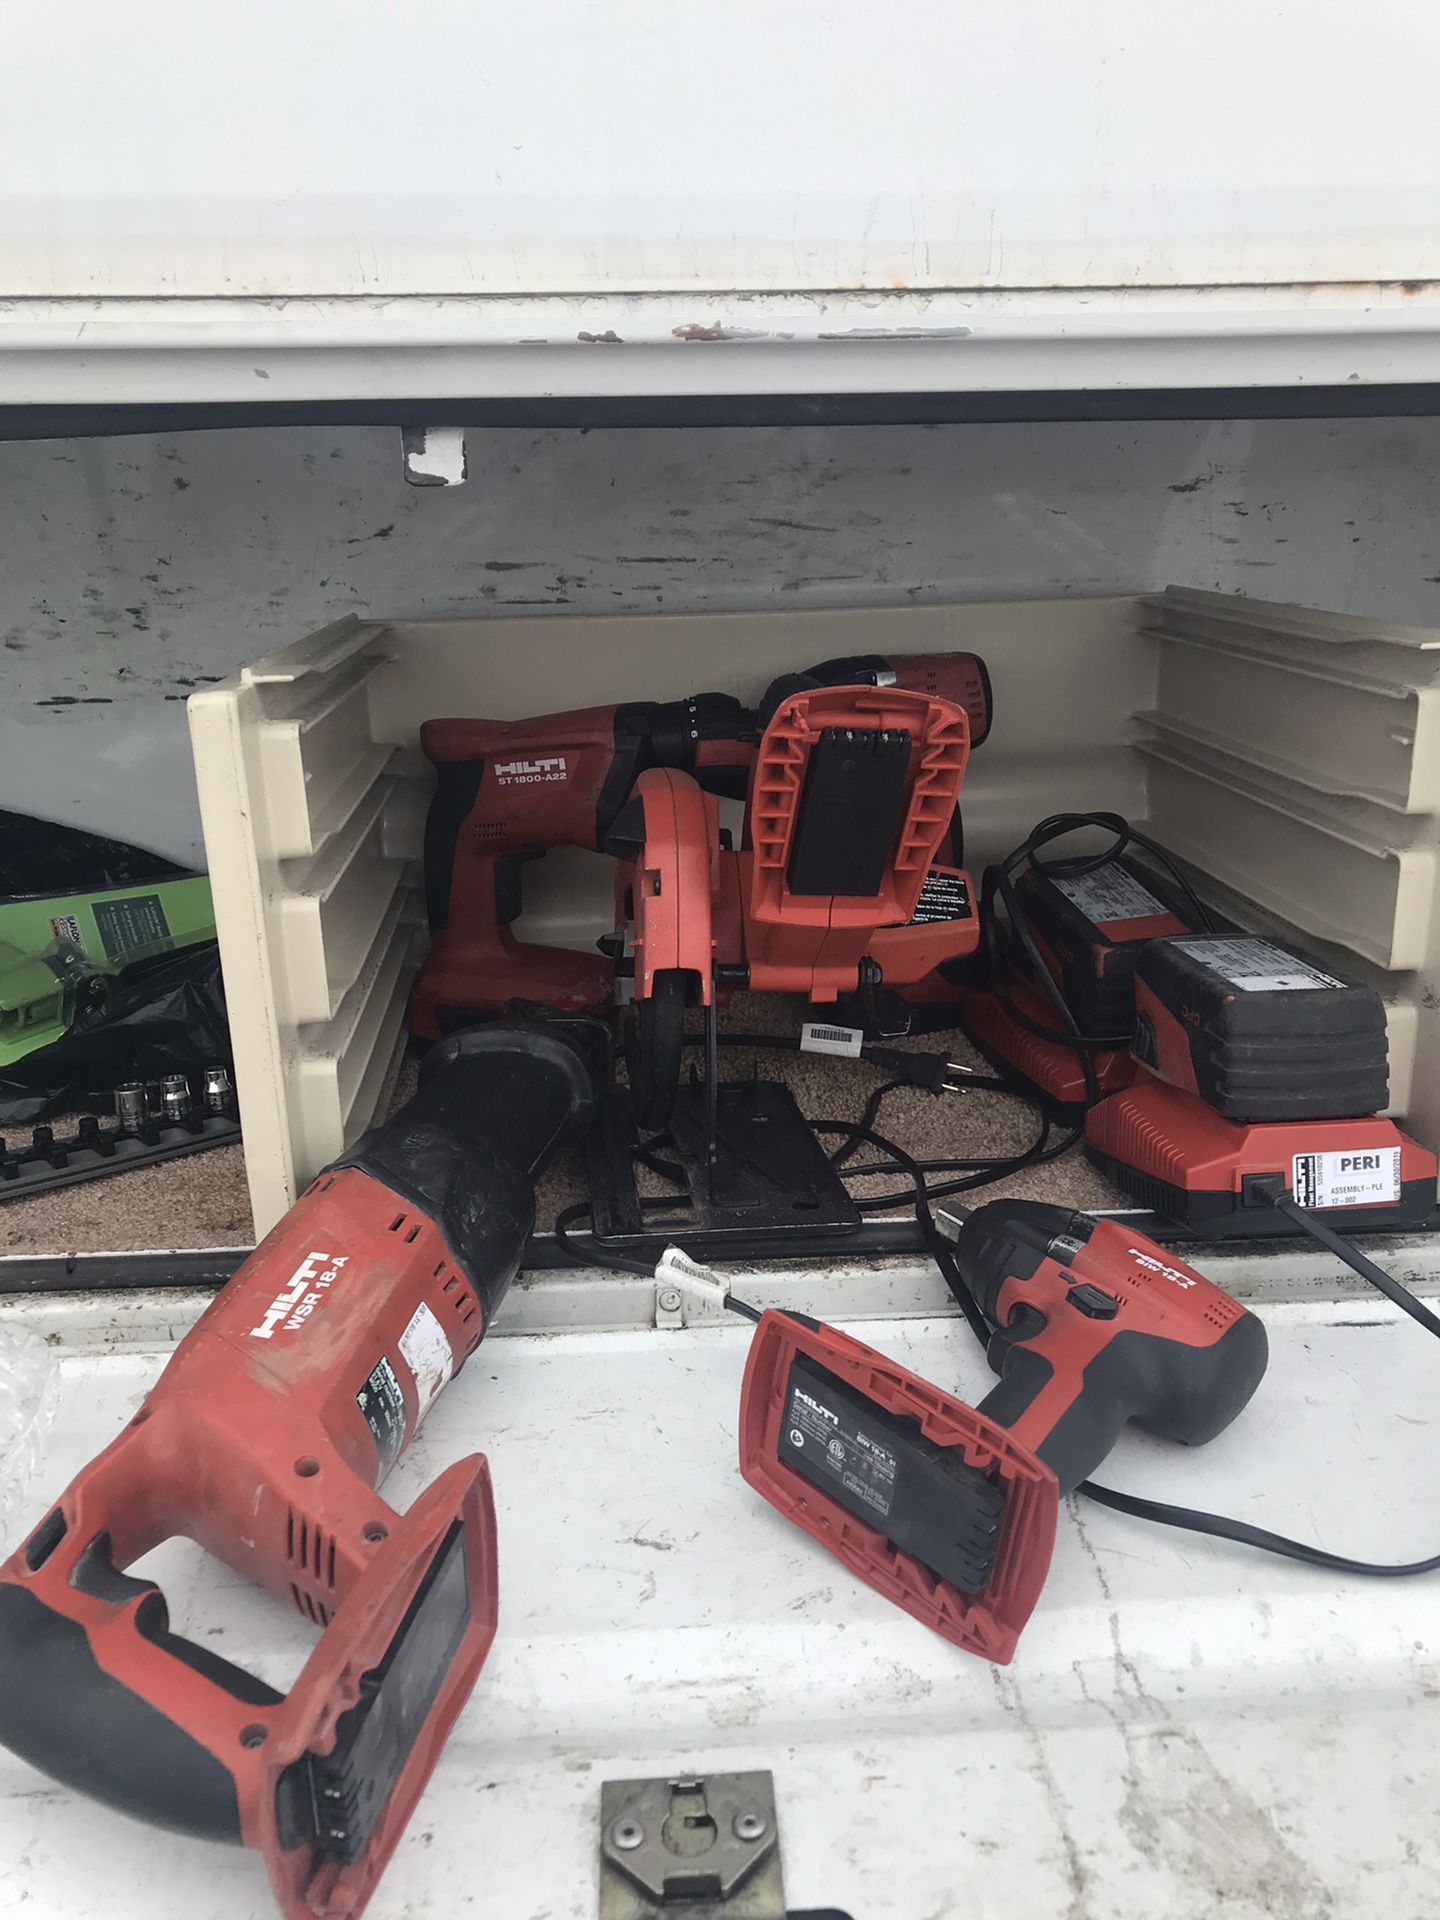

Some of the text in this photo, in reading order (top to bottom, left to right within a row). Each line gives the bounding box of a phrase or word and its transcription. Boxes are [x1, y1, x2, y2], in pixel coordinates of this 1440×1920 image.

[494, 757, 566, 776] HILTI
[498, 772, 567, 785] ST 1800-A22
[1340, 1155, 1380, 1172] PERI
[1296, 1157, 1307, 1208] HILTI
[1330, 1184, 1365, 1195] ASSEMBLY
[1127, 1248, 1198, 1286] HILTI
[1135, 1258, 1189, 1290] SIW 18-A
[249, 1251, 331, 1339] HILTI
[282, 1256, 350, 1330] WSR 18-A
[794, 1387, 839, 1426] HILTI
